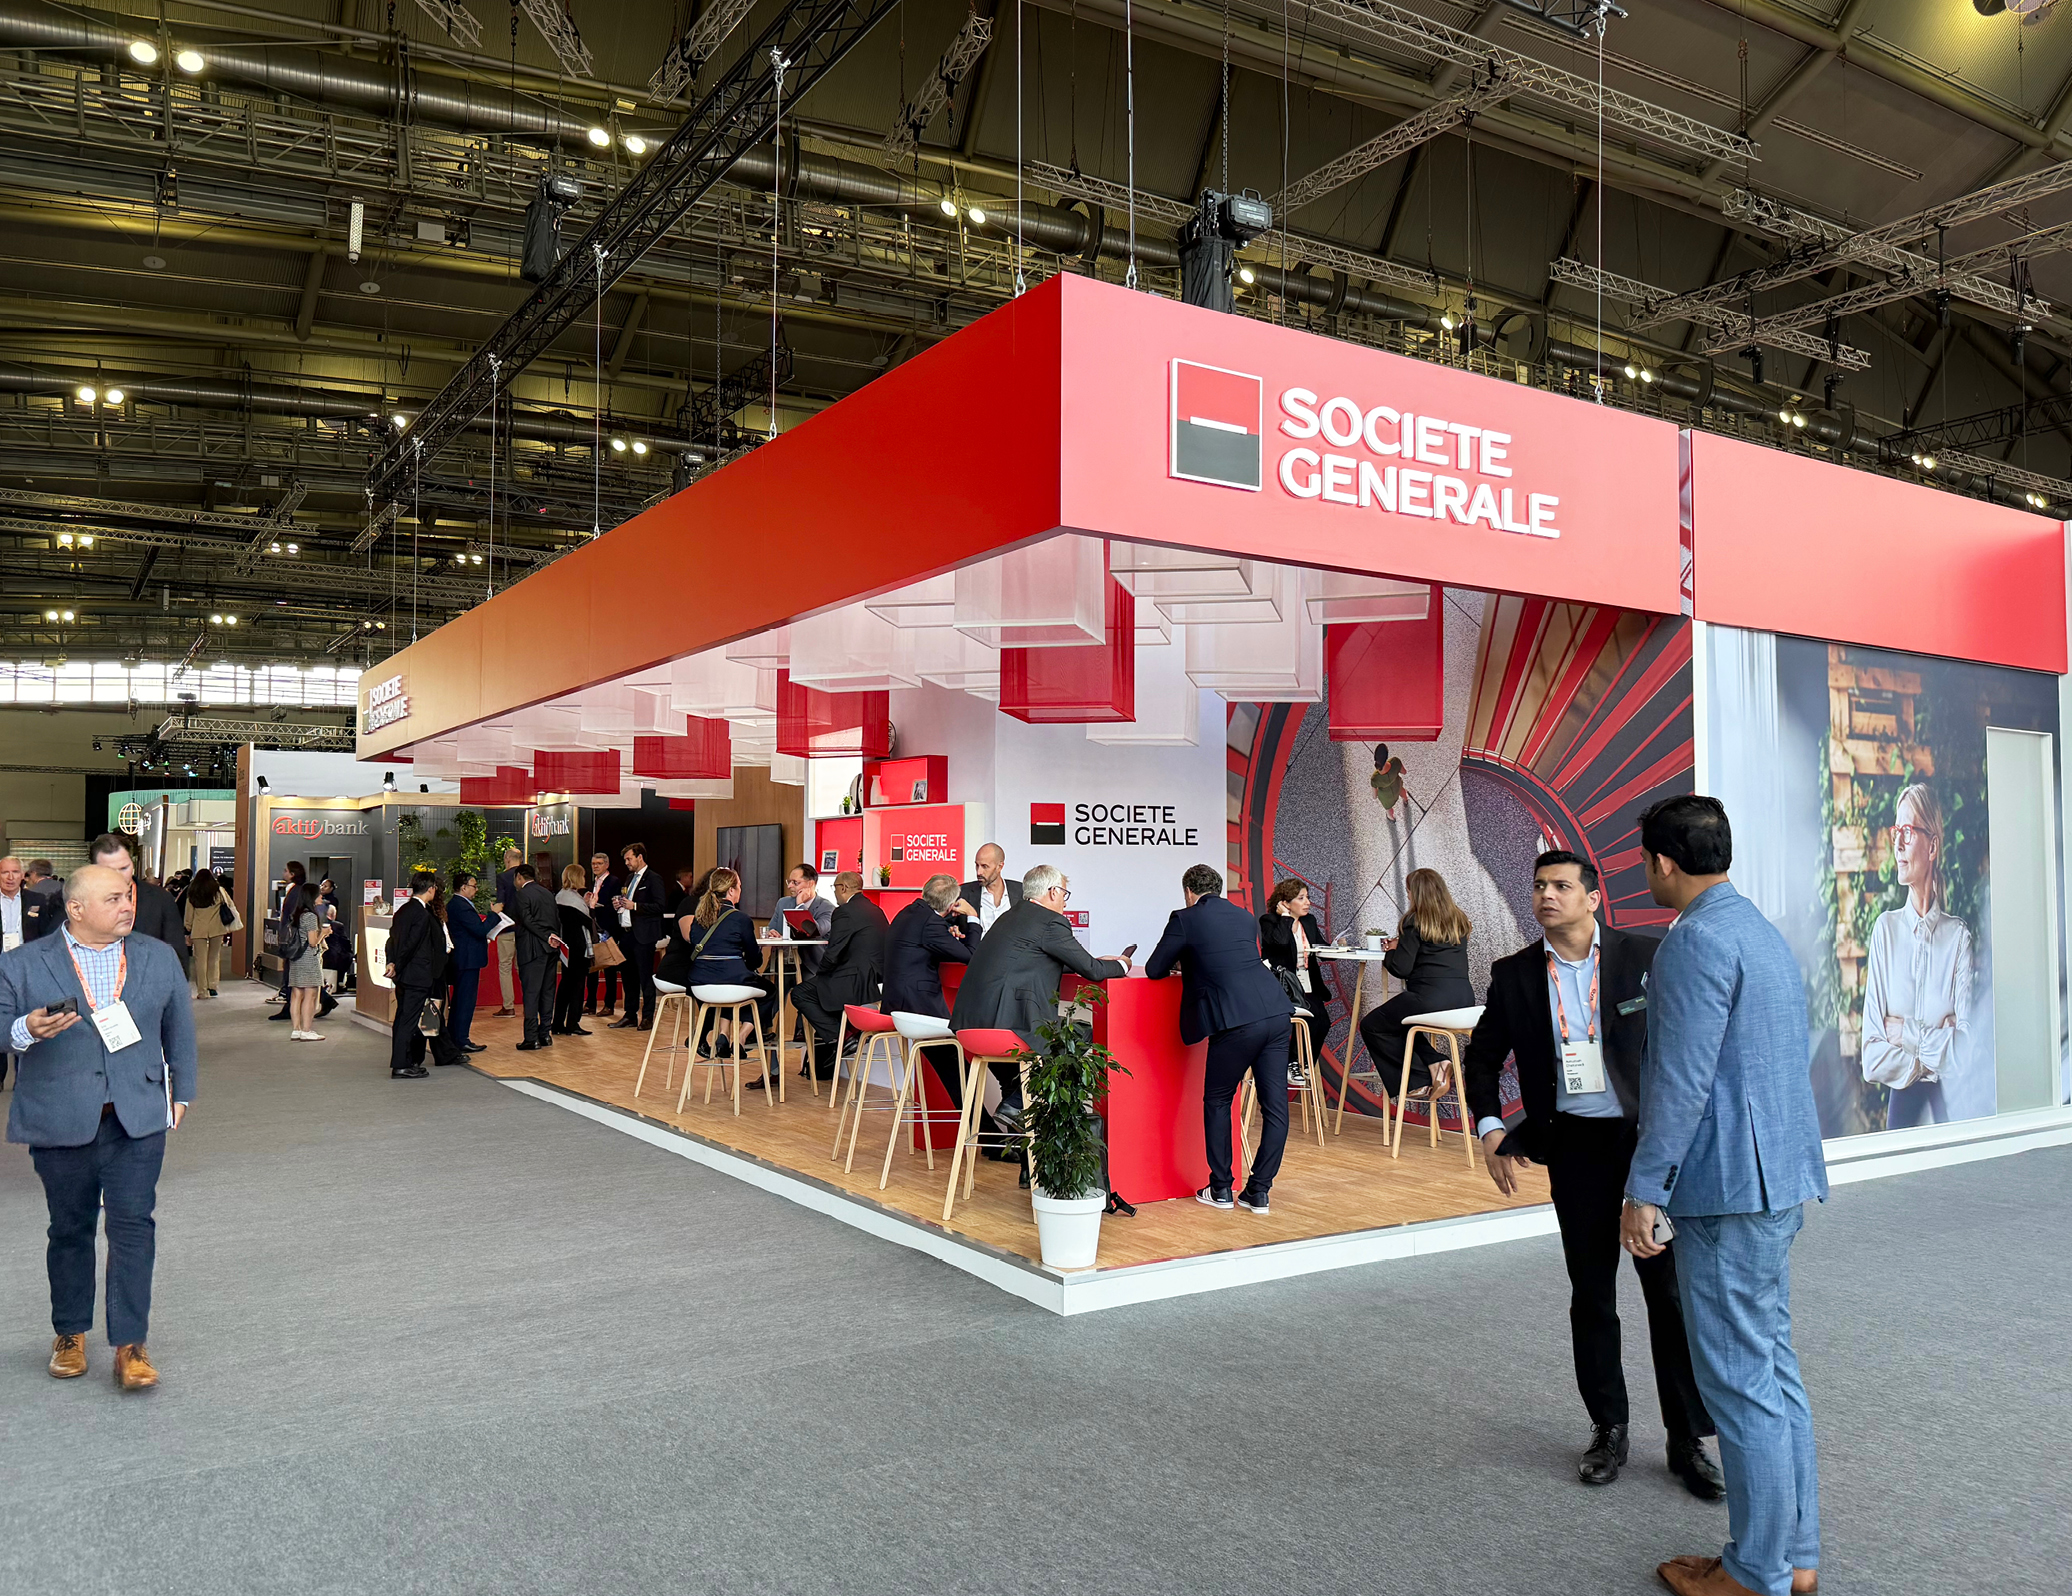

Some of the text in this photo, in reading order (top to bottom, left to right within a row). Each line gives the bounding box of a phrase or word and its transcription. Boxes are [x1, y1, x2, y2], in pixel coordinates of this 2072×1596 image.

[1280, 388, 1512, 477] SOCIETE
[1279, 448, 1560, 538] GENERALE
[1075, 804, 1176, 823] SOCIETE
[273, 817, 370, 837] aktif bank
[1075, 827, 1198, 845] GENERALE
[906, 834, 947, 847] SOCIETE
[906, 849, 957, 861] GENERALE
